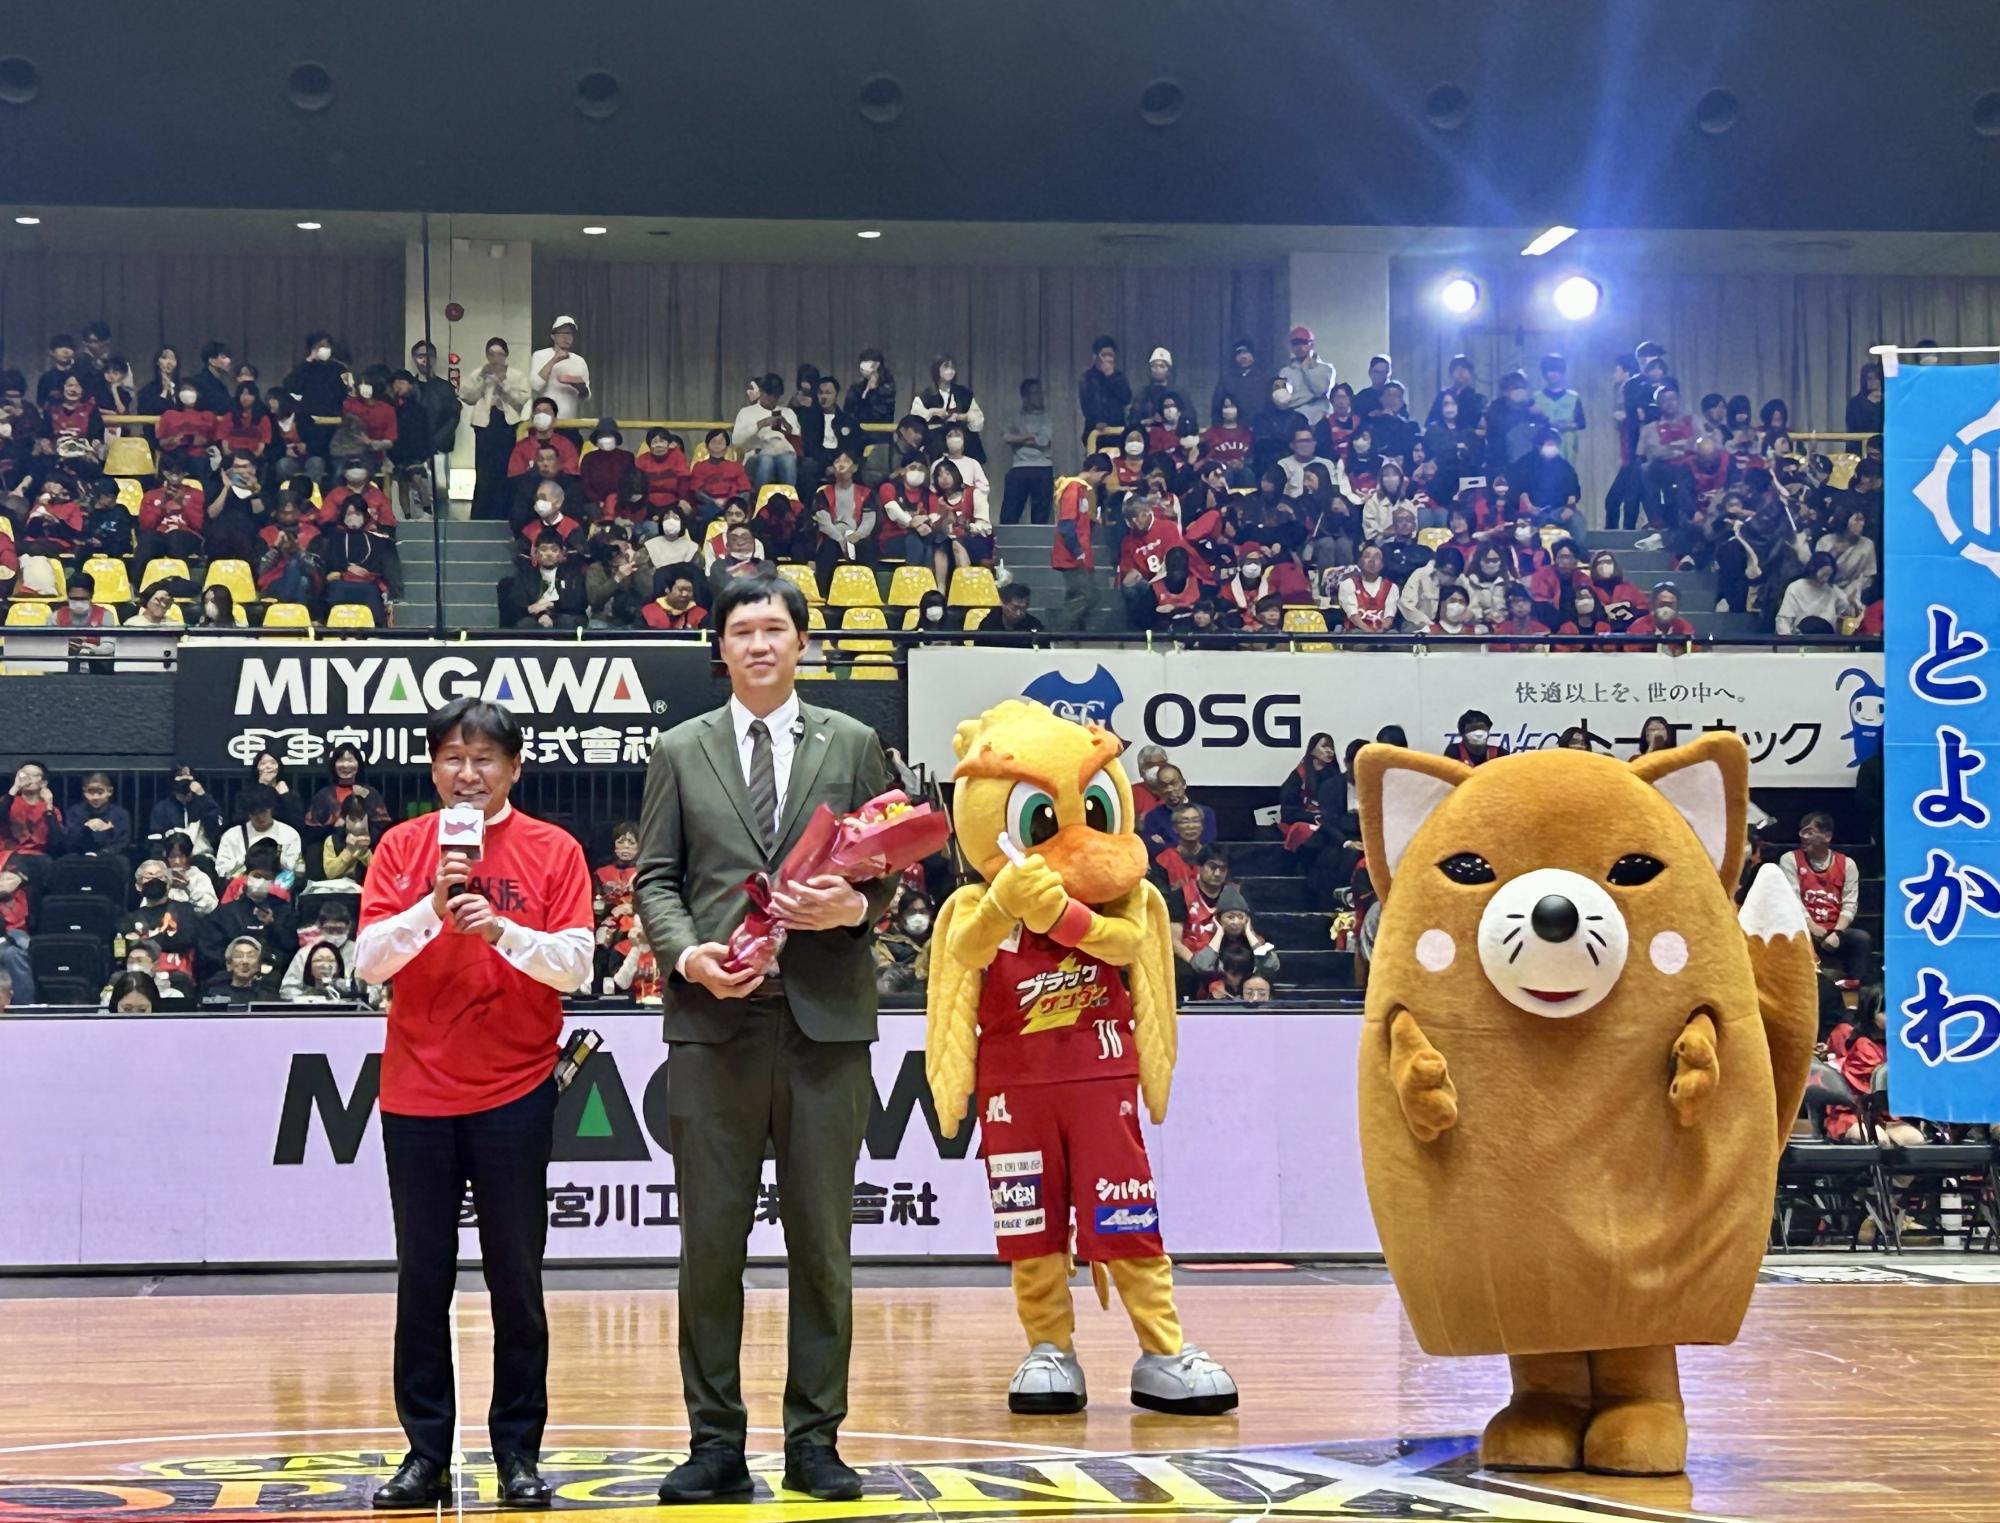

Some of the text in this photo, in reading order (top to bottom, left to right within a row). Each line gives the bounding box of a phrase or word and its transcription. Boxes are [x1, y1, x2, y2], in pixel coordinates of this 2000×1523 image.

[234, 657, 651, 715] MIYAGAWA
[1515, 681, 1746, 704] 快適以上を、世の中へ。
[1143, 692, 1302, 748] OSG
[1900, 604, 2000, 1068] とよかわ
[1017, 964, 1098, 1007] ブラック
